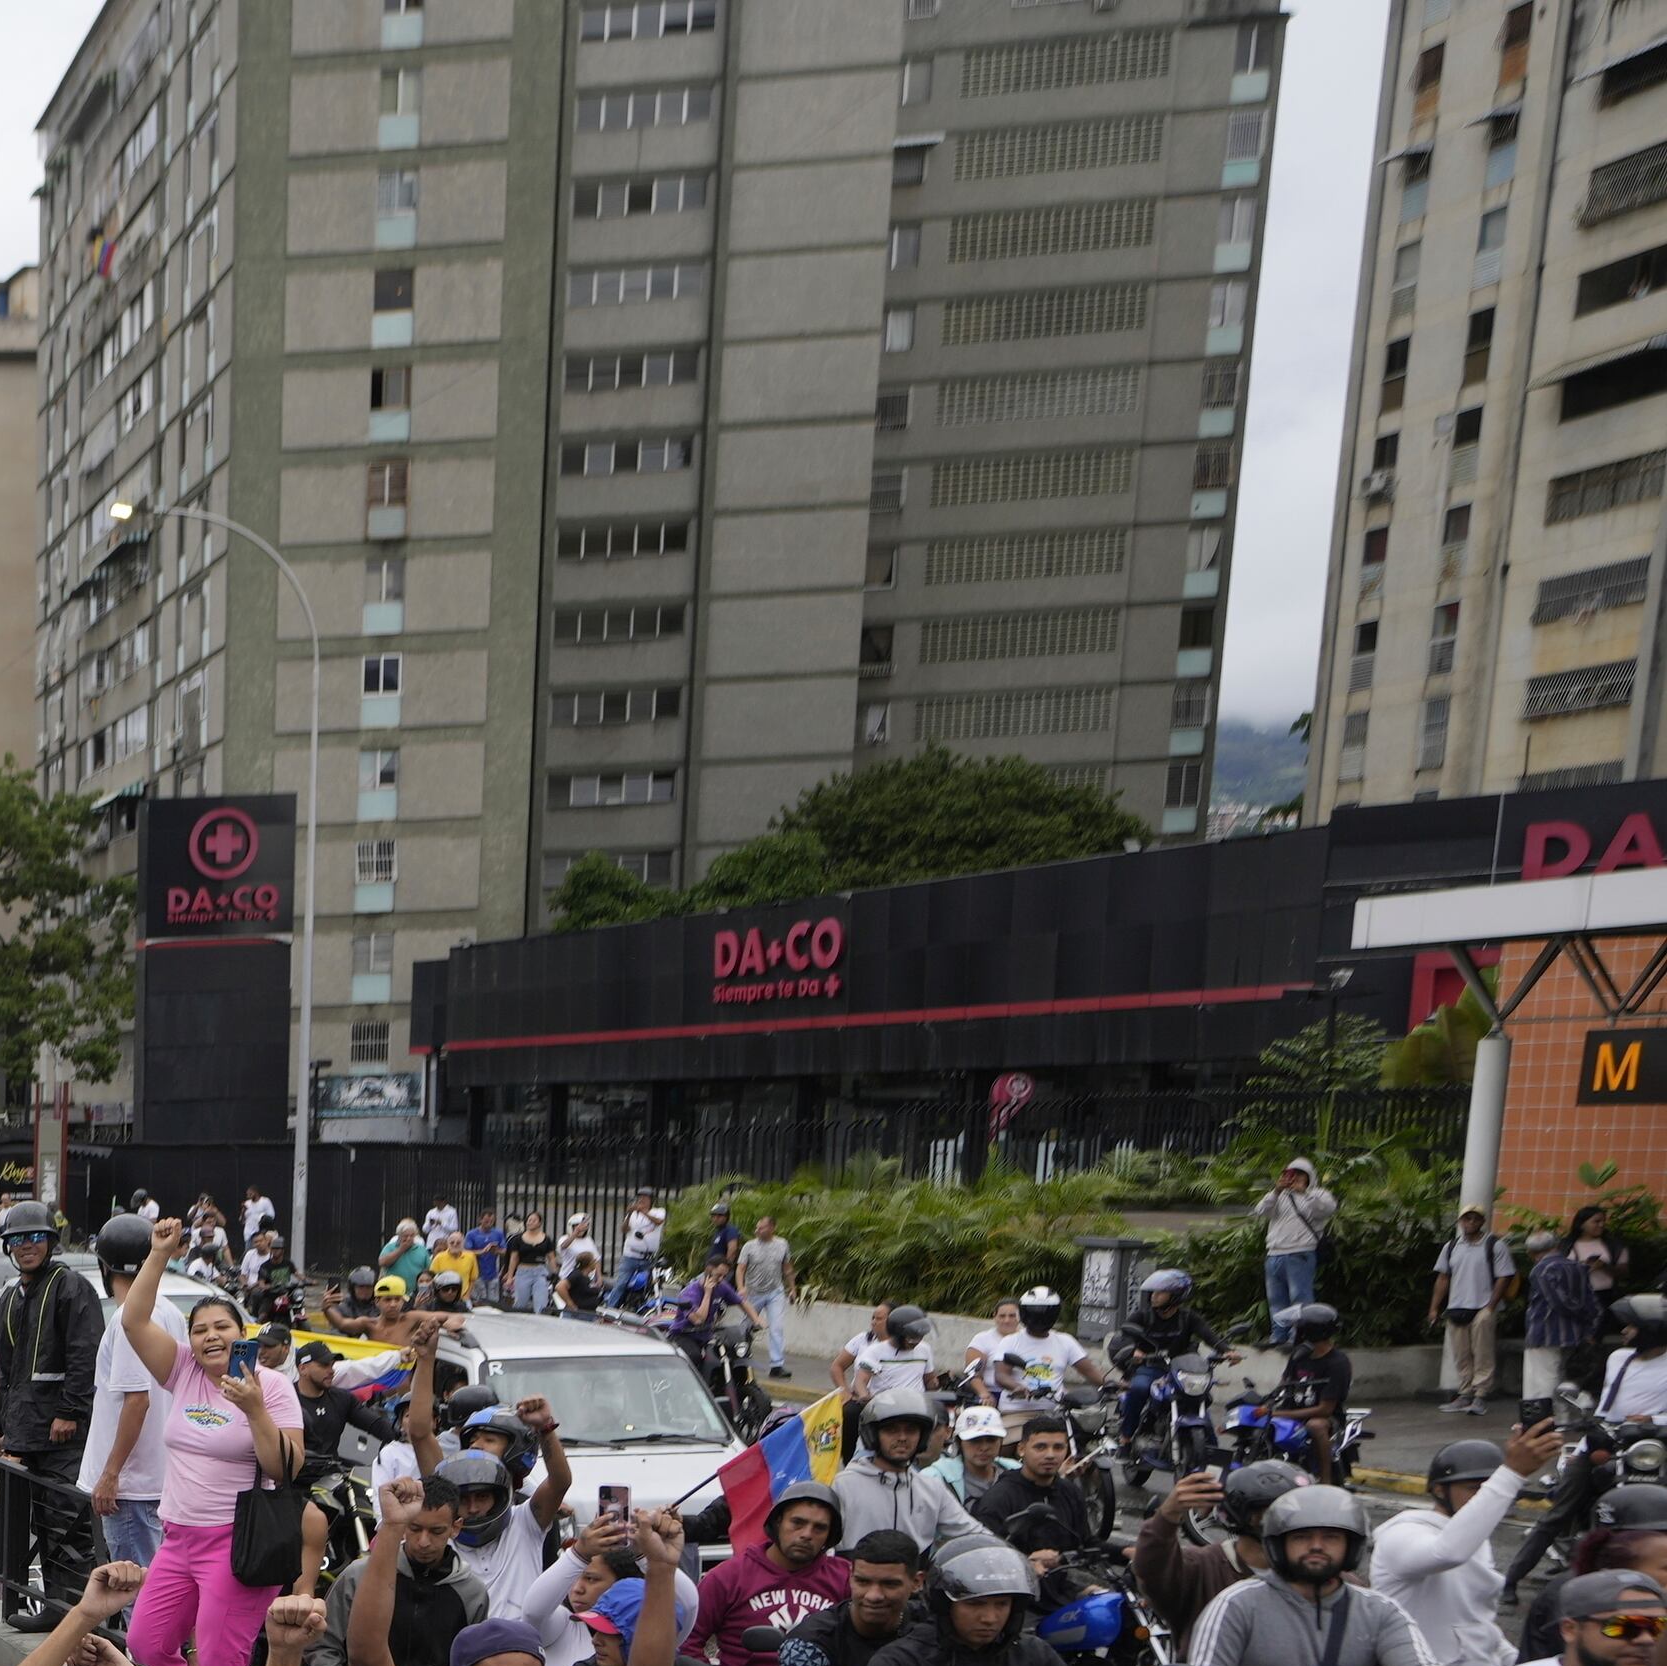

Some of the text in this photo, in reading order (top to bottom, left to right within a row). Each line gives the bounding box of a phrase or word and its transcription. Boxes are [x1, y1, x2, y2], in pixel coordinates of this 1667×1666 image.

[714, 982, 775, 1004] Siempre
[777, 979, 794, 998] te
[798, 979, 820, 997] Da
[1593, 1041, 1642, 1092] M
[750, 1590, 785, 1612] NEW
